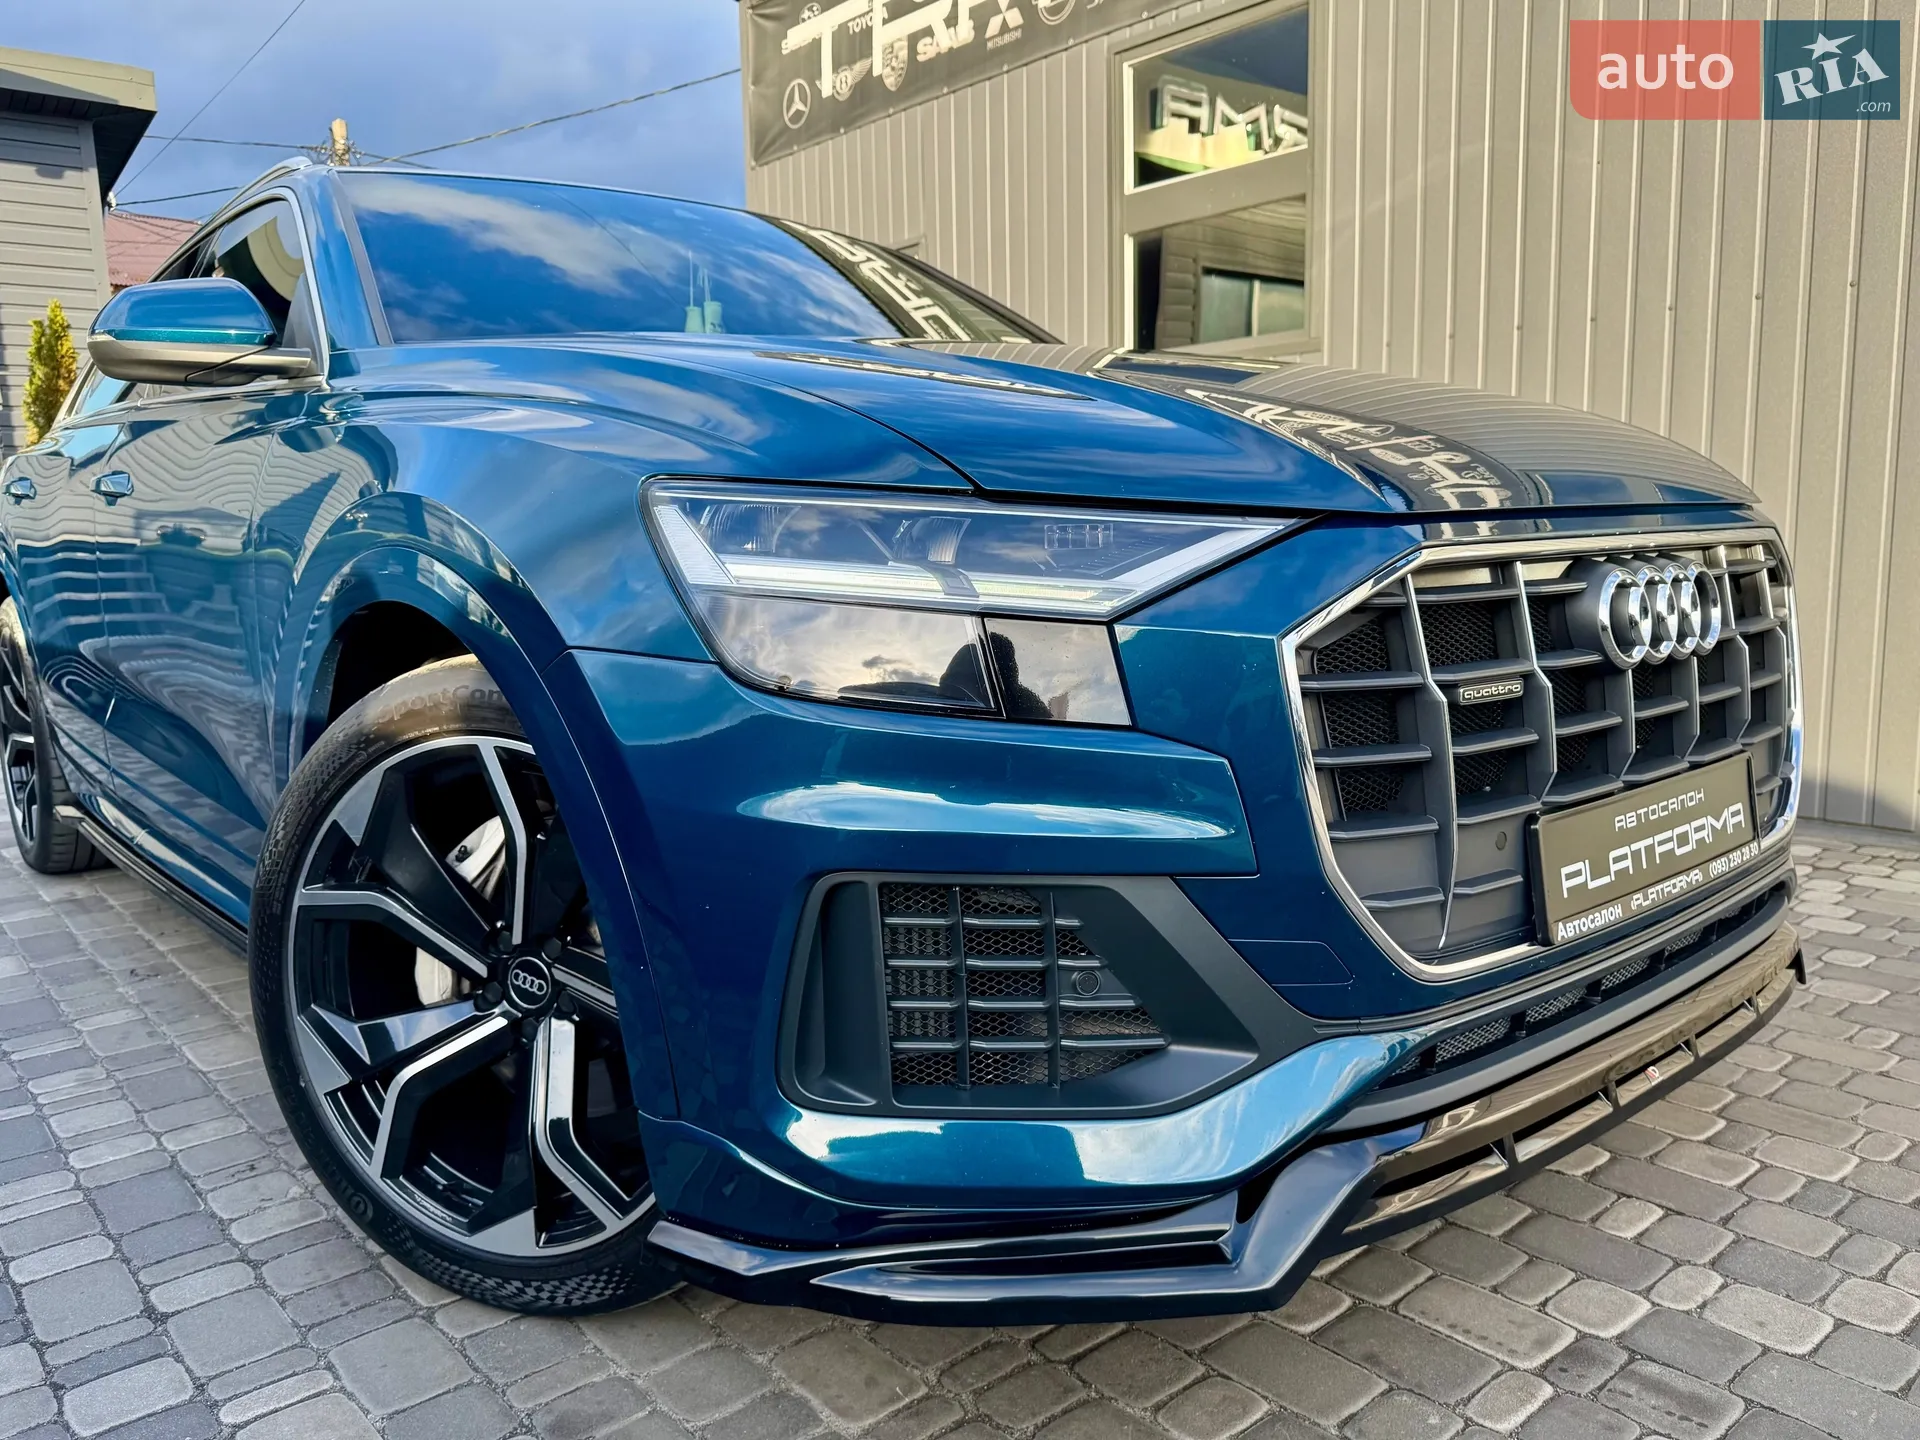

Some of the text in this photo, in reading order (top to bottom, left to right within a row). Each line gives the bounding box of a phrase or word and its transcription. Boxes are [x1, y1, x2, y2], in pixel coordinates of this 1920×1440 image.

[847, 6, 888, 35] TOYOA
[1464, 684, 1521, 700] quattro
[1560, 802, 1745, 899] PLATFORMA
[1557, 903, 1623, 941] Автосалон
[1708, 857, 1729, 879] (093)
[1729, 850, 1742, 868] 230
[1750, 841, 1759, 857] 30
